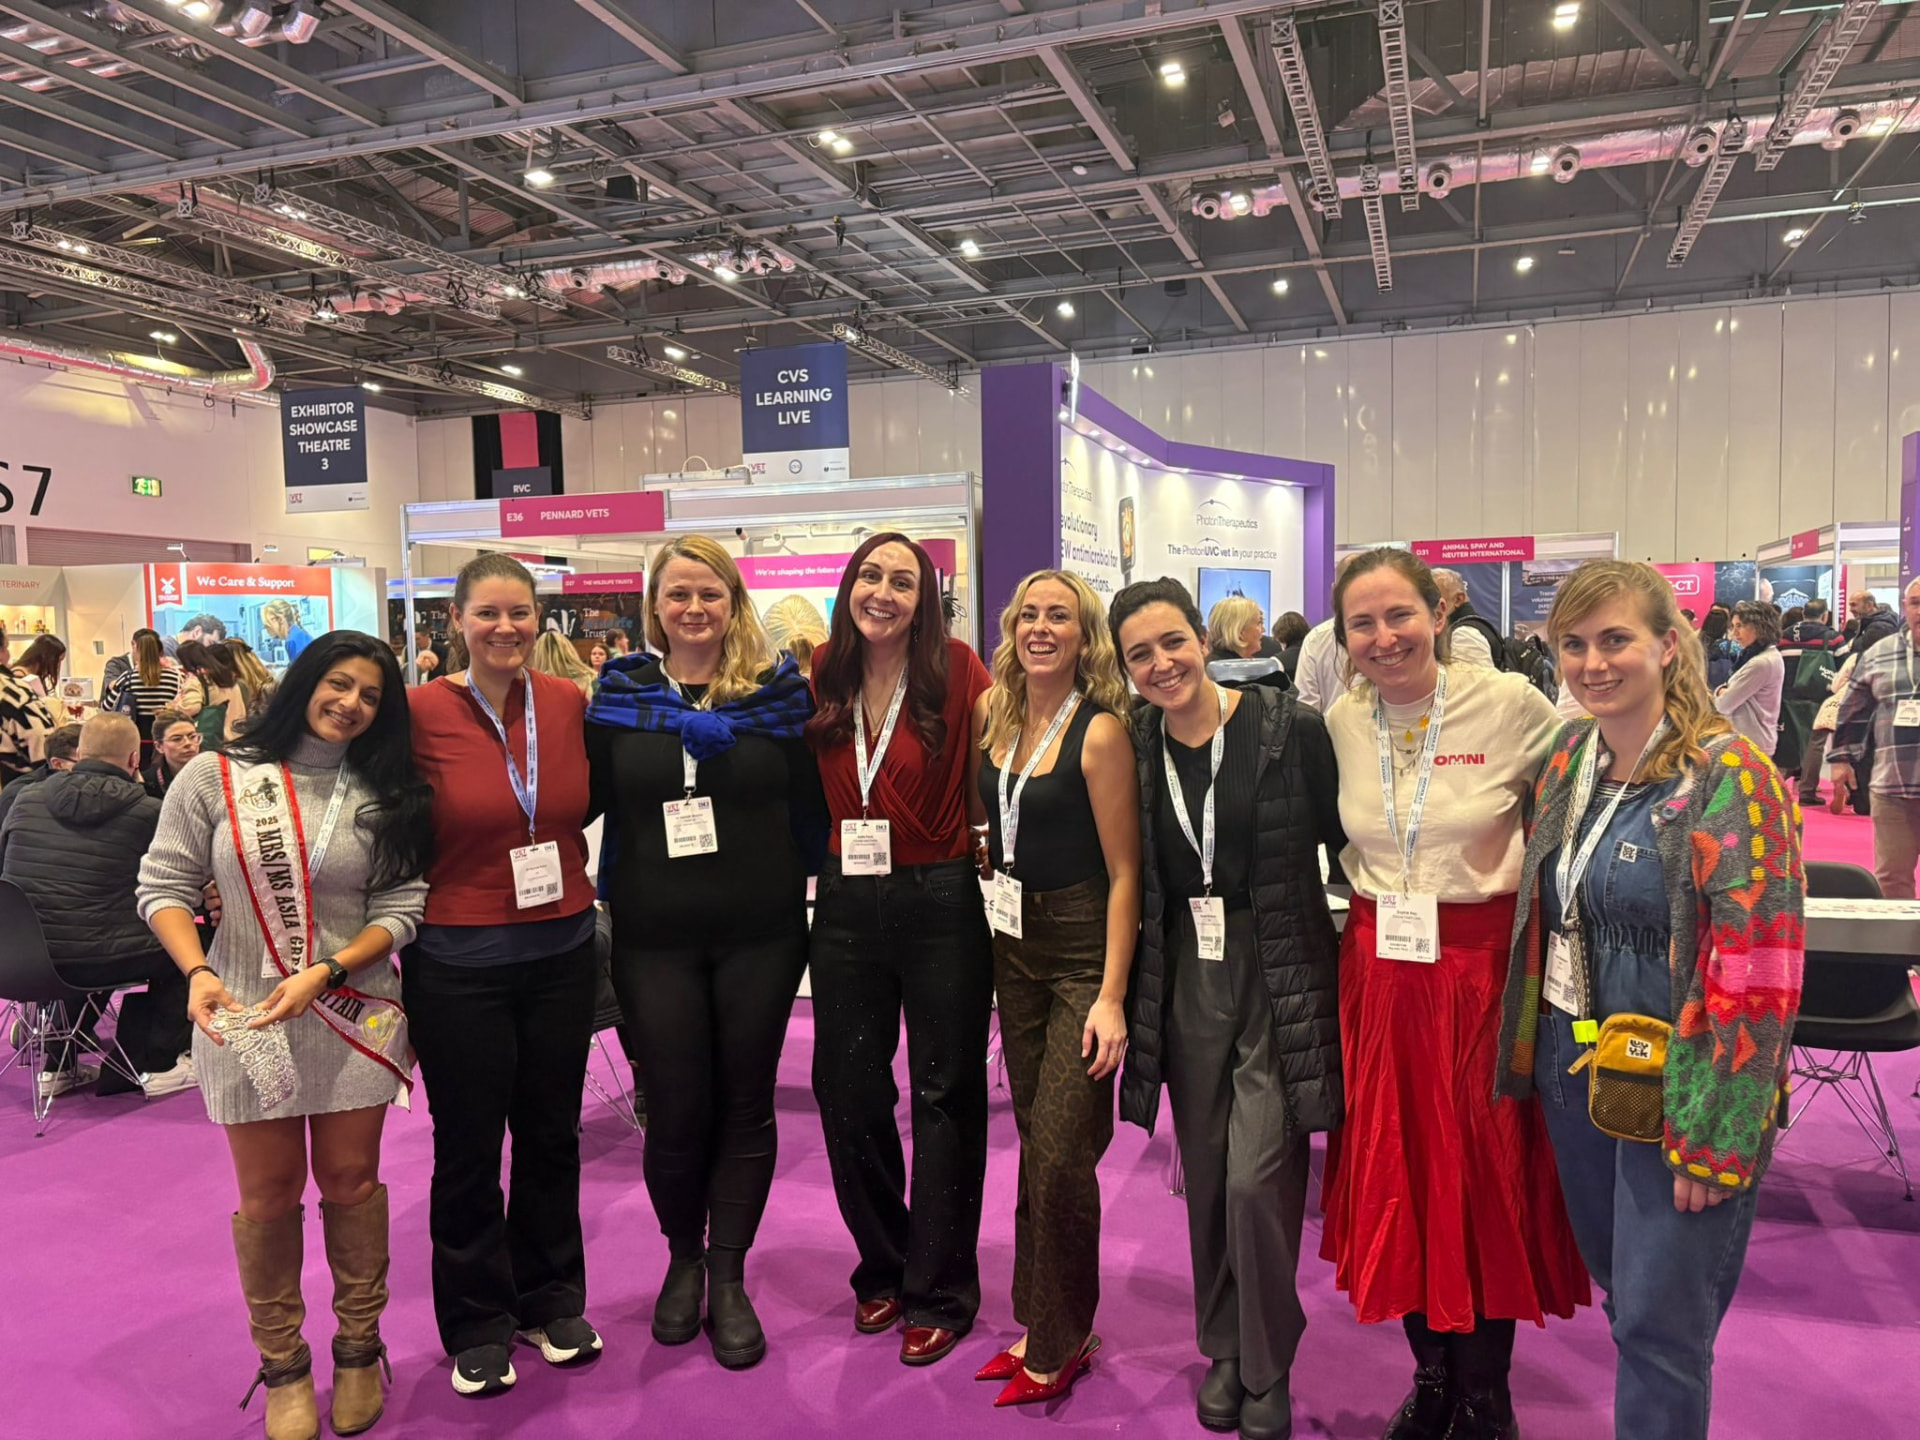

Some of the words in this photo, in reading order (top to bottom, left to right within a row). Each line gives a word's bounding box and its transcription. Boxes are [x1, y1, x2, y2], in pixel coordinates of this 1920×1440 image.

[777, 369, 809, 384] CVS
[756, 387, 833, 406] LEARNING
[291, 401, 354, 418] EXHIBITOR
[778, 410, 811, 425] LIVE
[289, 420, 358, 436] SHOWCASE
[298, 438, 351, 453] THEATRE
[321, 457, 329, 470] 3
[512, 484, 532, 493] RVC
[506, 512, 524, 522] E36
[540, 509, 584, 521] PENNARD
[585, 508, 610, 518] VETS
[1168, 543, 1182, 555] The
[1220, 547, 1231, 557] vet
[1231, 547, 1239, 557] in
[1239, 549, 1253, 560] your
[1253, 548, 1278, 560] practice
[1442, 543, 1469, 551] ANIMAL
[1470, 542, 1488, 550] SPAY
[1489, 541, 1505, 549] AND
[1442, 551, 1469, 559] NEUTER
[1469, 549, 1526, 558] INTERNATIONAL
[755, 568, 776, 576] We're
[777, 567, 804, 577] shaping
[805, 567, 816, 575] the
[816, 566, 835, 574] future
[196, 576, 216, 586] We
[218, 576, 244, 587] Care
[246, 576, 256, 587] &
[258, 576, 295, 590] Support
[430, 610, 448, 620] The
[583, 607, 600, 617] The
[1433, 753, 1485, 767] OMNI
[256, 816, 278, 828] 2025
[276, 895, 300, 930] ASIA
